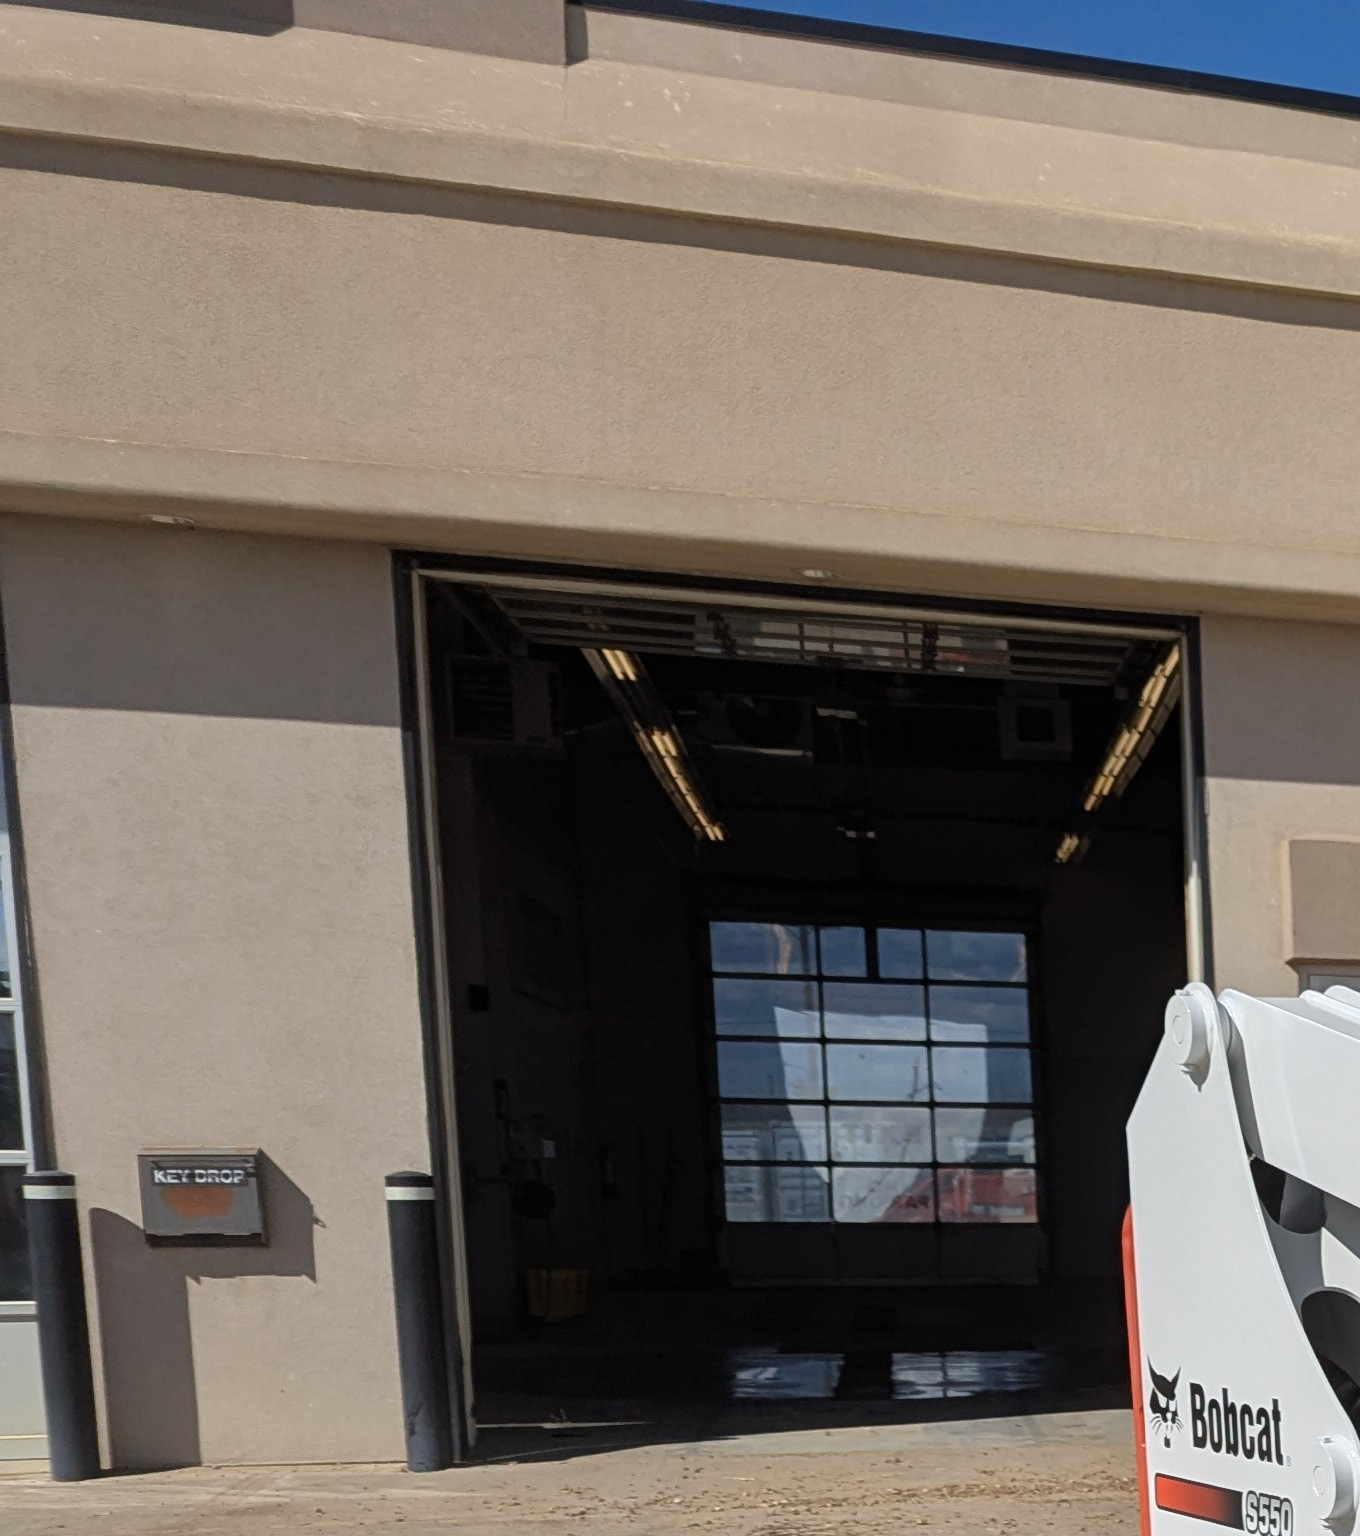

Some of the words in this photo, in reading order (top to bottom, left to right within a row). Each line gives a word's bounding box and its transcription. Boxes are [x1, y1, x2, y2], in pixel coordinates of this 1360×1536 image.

[153, 1169, 191, 1184] KEY
[194, 1169, 245, 1184] DROP
[1189, 1382, 1284, 1466] Bobcat
